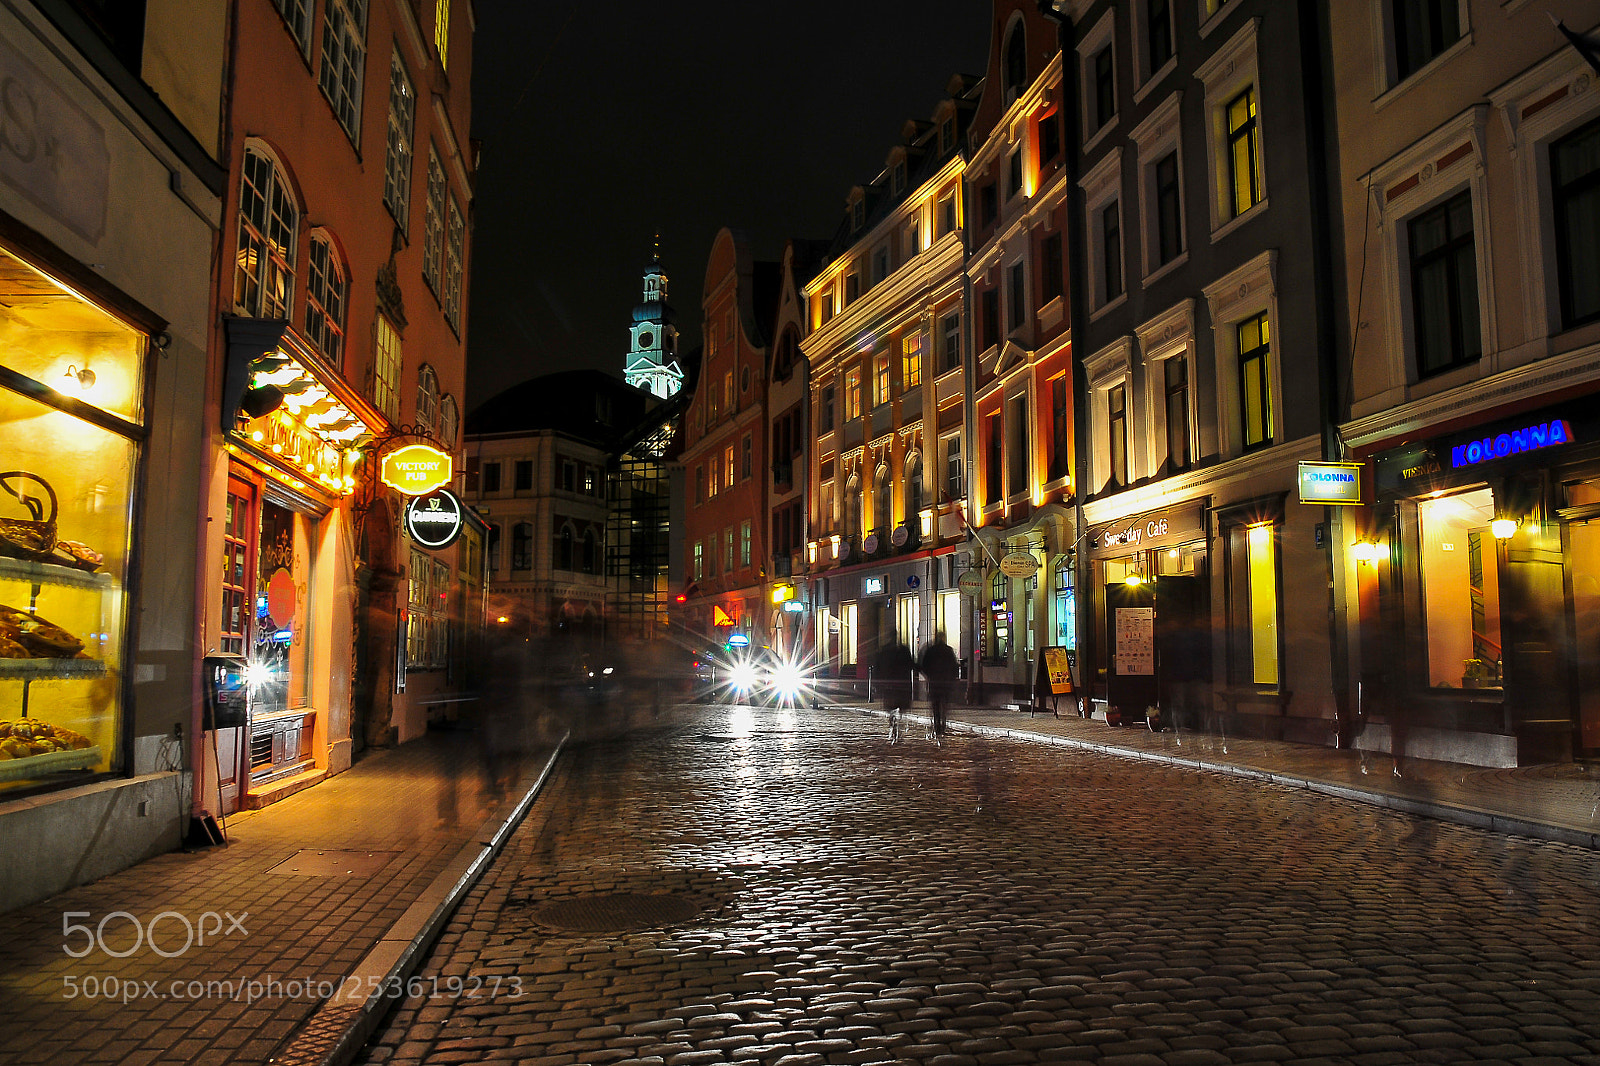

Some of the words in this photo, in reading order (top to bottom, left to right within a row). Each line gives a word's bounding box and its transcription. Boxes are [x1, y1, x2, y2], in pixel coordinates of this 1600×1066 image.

[1452, 419, 1568, 468] KOLONNA
[395, 462, 440, 471] VICTORY
[405, 472, 427, 481] PUB
[1303, 472, 1355, 482] KOLONNA
[1314, 484, 1346, 494] HOTEL
